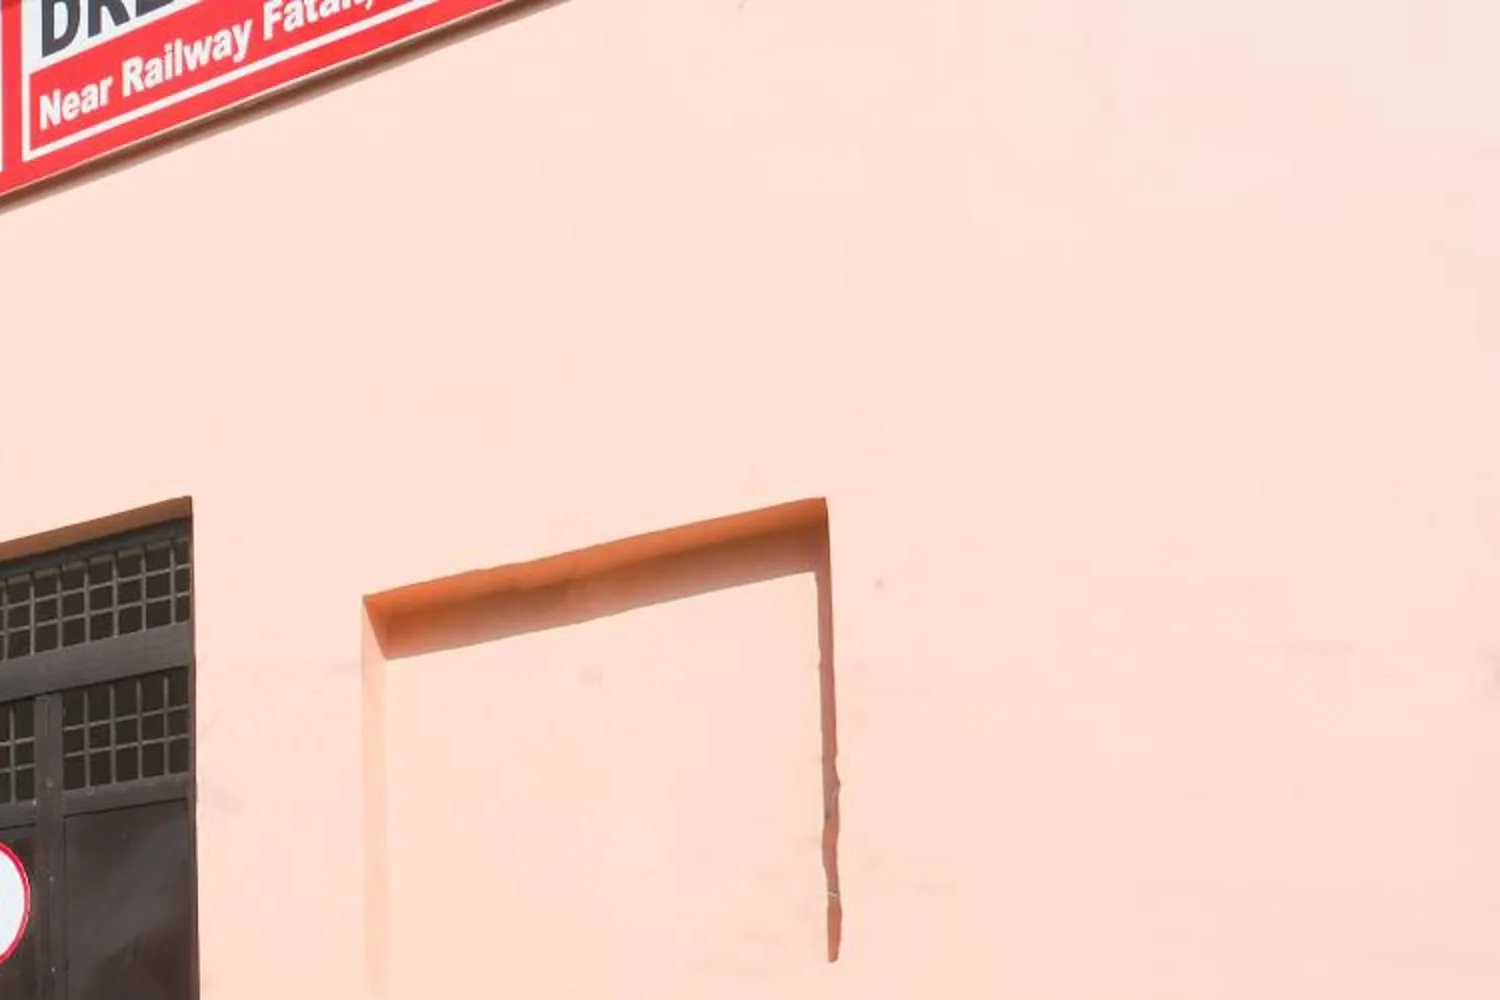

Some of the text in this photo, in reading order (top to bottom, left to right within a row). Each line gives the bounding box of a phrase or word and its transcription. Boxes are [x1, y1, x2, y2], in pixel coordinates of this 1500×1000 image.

[41, 0, 176, 58] DR
[39, 76, 114, 130] Near
[121, 19, 253, 98] Railway
